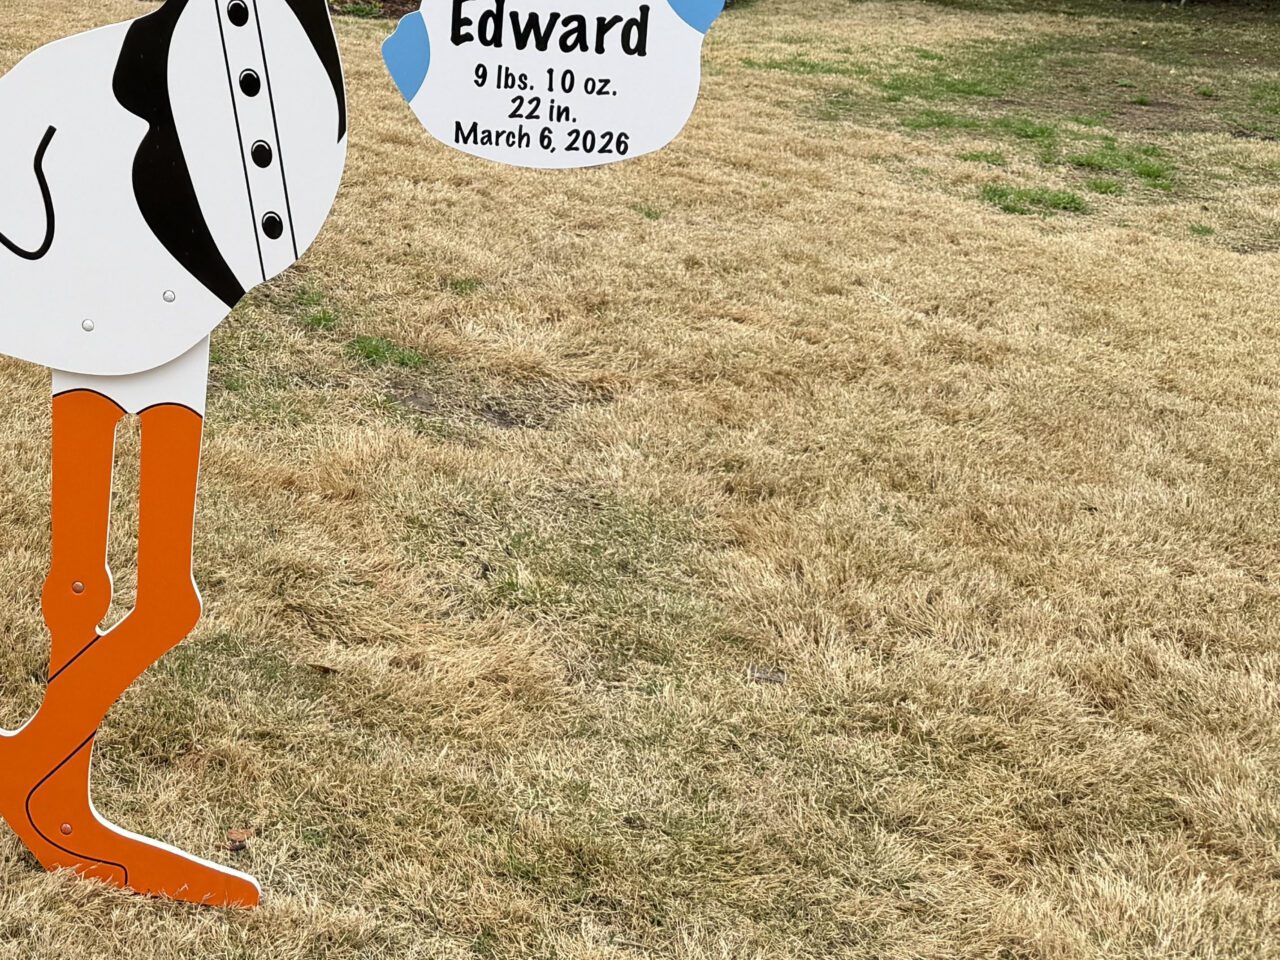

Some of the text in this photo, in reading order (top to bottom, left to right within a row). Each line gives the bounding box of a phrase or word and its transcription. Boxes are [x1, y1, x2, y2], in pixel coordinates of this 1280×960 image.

[473, 63, 617, 97] 9 lbs. 10 oz.
[508, 95, 577, 123] 22 in.
[454, 120, 630, 156] March 6, 2026
